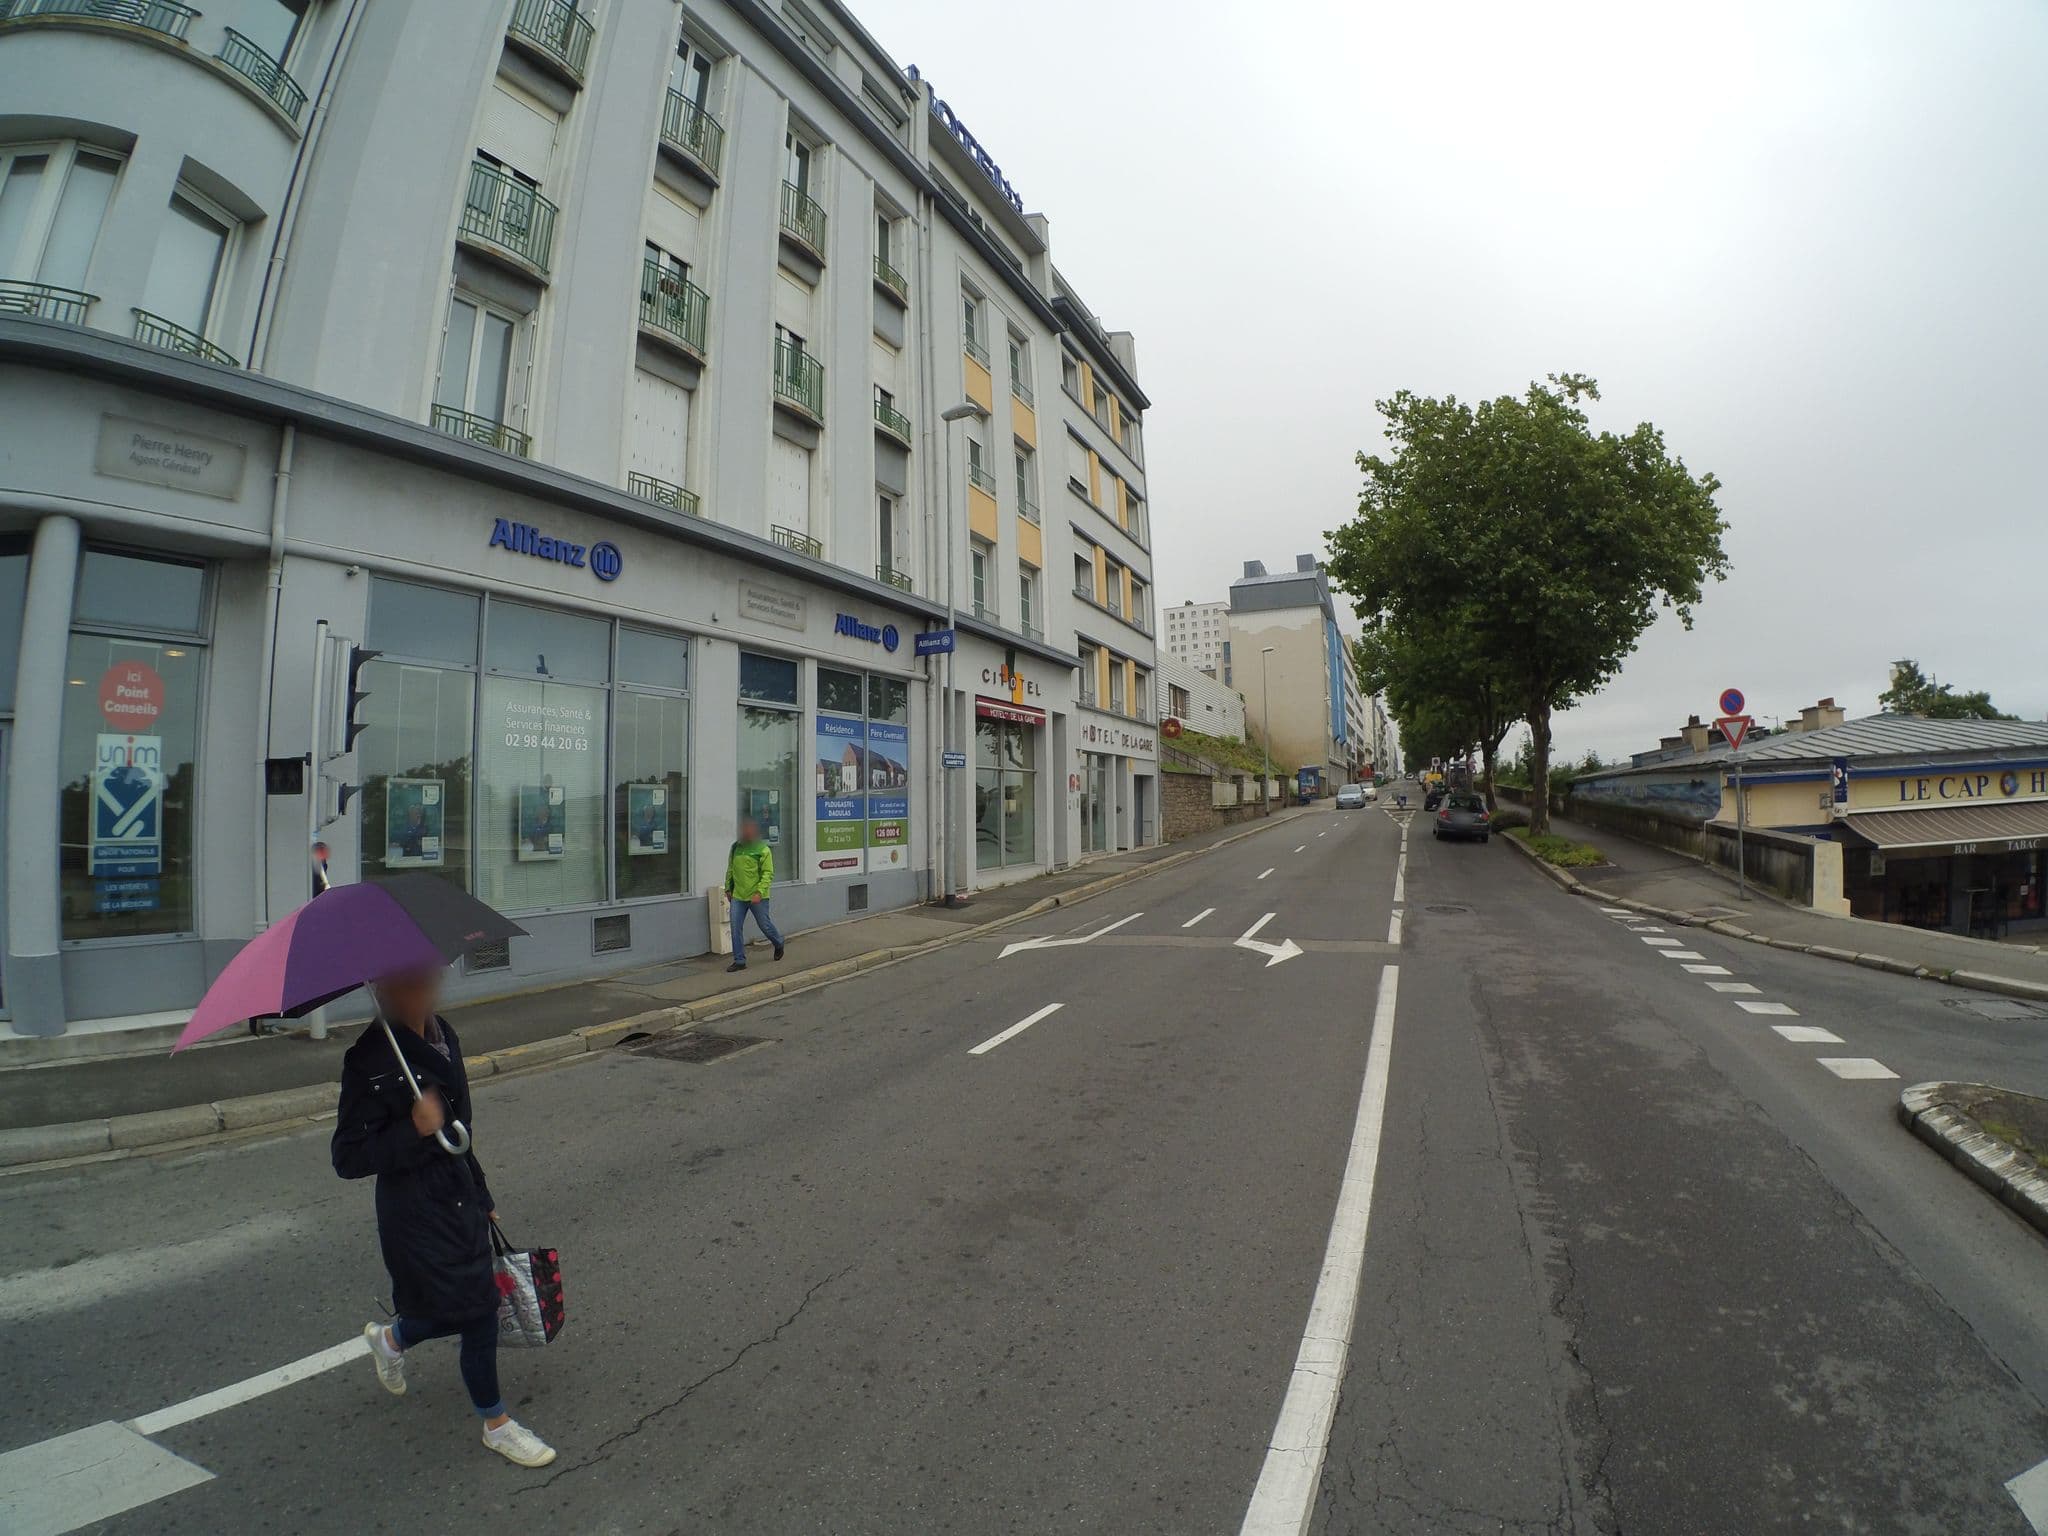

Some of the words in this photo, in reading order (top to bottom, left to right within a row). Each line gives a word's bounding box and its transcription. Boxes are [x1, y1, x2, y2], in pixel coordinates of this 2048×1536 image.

[133, 432, 171, 454] Pierre
[174, 442, 213, 466] Henry
[489, 517, 587, 568] Allianz
[834, 612, 881, 644] Allianz
[918, 638, 941, 648] Allianz
[116, 684, 150, 699] Point
[104, 699, 159, 716] Conseils
[505, 701, 558, 718] Assurances,
[559, 706, 583, 720] Santé
[505, 717, 543, 732] Services
[544, 720, 585, 735] financiers
[825, 723, 855, 735] Résidence
[505, 733, 520, 747] 02
[523, 734, 538, 748] 98
[541, 735, 555, 749] 44
[558, 737, 572, 750] 20
[574, 738, 588, 751] 63
[99, 735, 159, 768] unim
[1899, 779, 1931, 801] LE
[1938, 775, 1990, 799] CAP
[1954, 843, 1977, 855] BAR
[2007, 838, 2041, 851] TABAC
